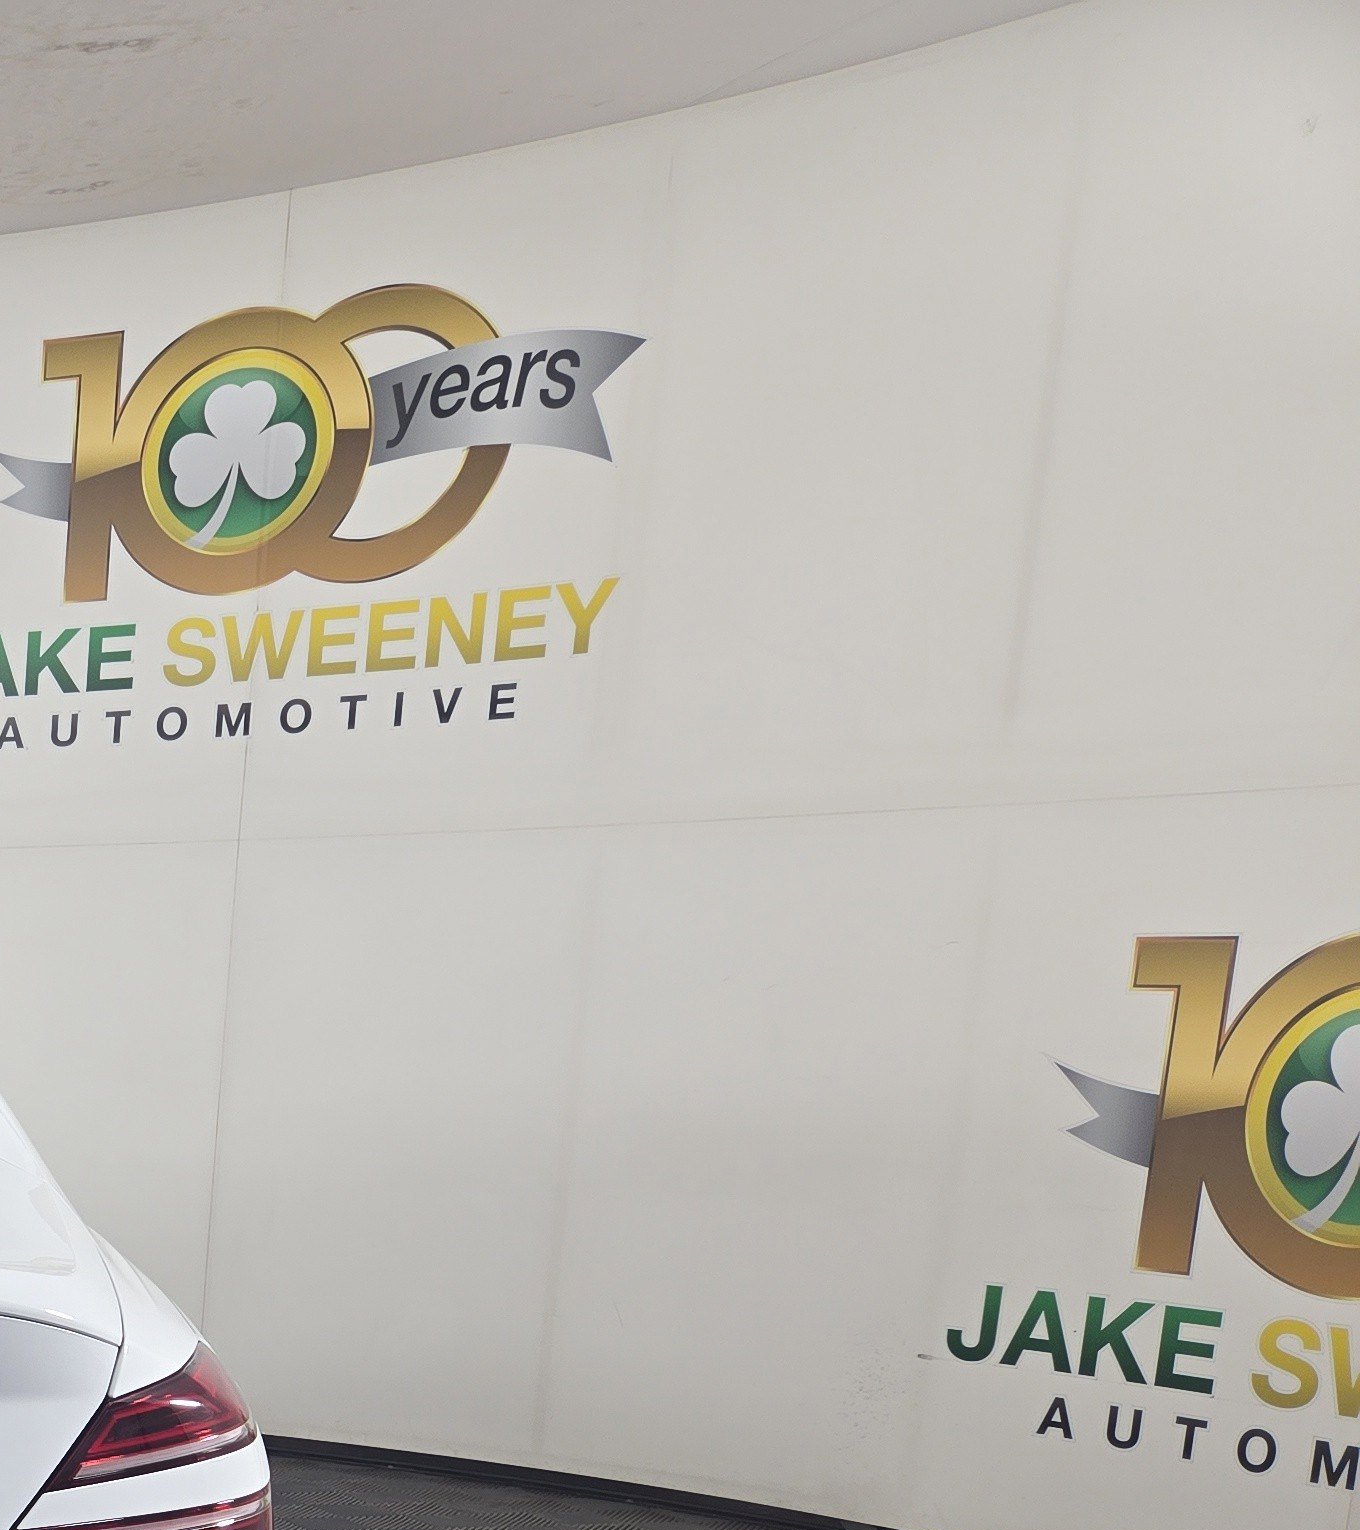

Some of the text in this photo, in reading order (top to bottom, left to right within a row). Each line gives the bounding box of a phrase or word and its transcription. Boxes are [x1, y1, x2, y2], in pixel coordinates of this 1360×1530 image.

[41, 283, 513, 603] 100
[385, 347, 580, 449] years
[163, 577, 621, 687] SWEENEY
[947, 1285, 1223, 1395] JAKE
